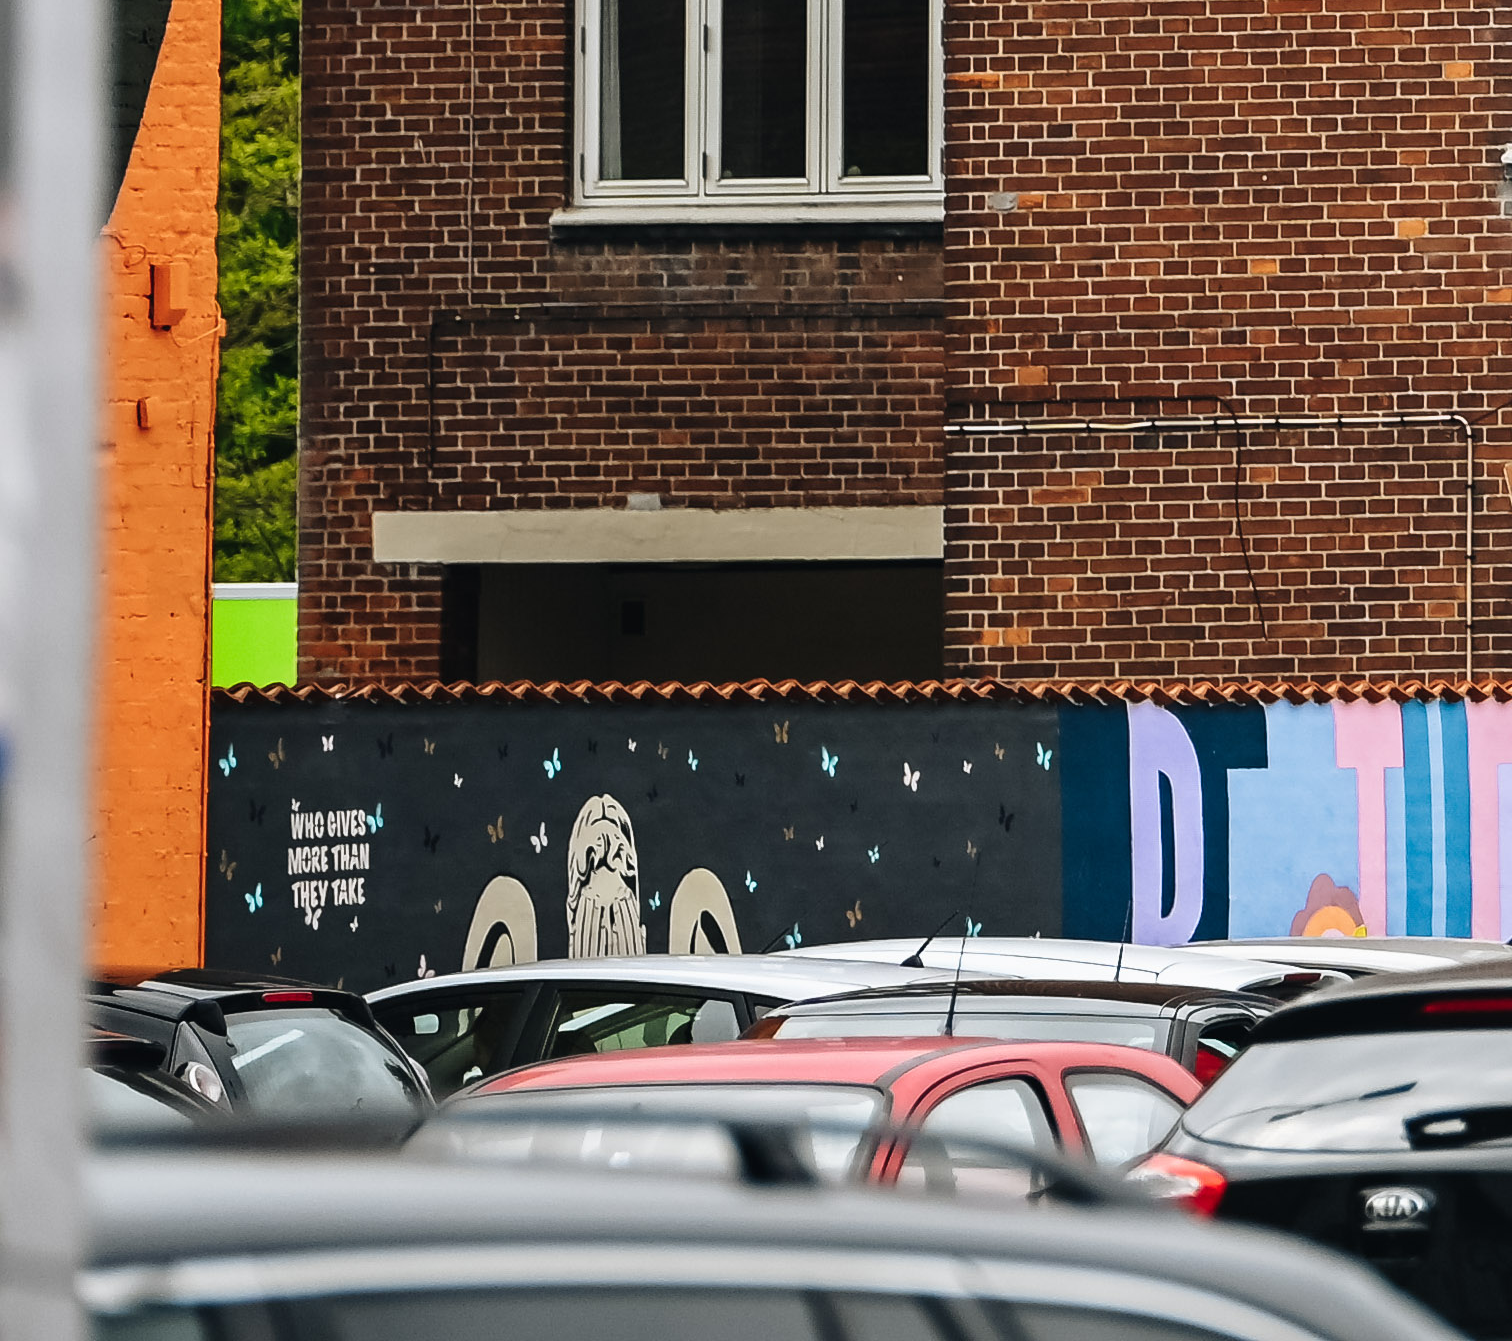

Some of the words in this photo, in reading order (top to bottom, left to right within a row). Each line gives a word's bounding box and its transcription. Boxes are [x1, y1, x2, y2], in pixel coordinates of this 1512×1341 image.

[291, 811, 324, 840] WHO
[327, 809, 366, 837] GIVES
[288, 845, 328, 875] MORE
[331, 843, 370, 872] THAN
[291, 880, 328, 908] THEY
[331, 877, 366, 906] TAKE
